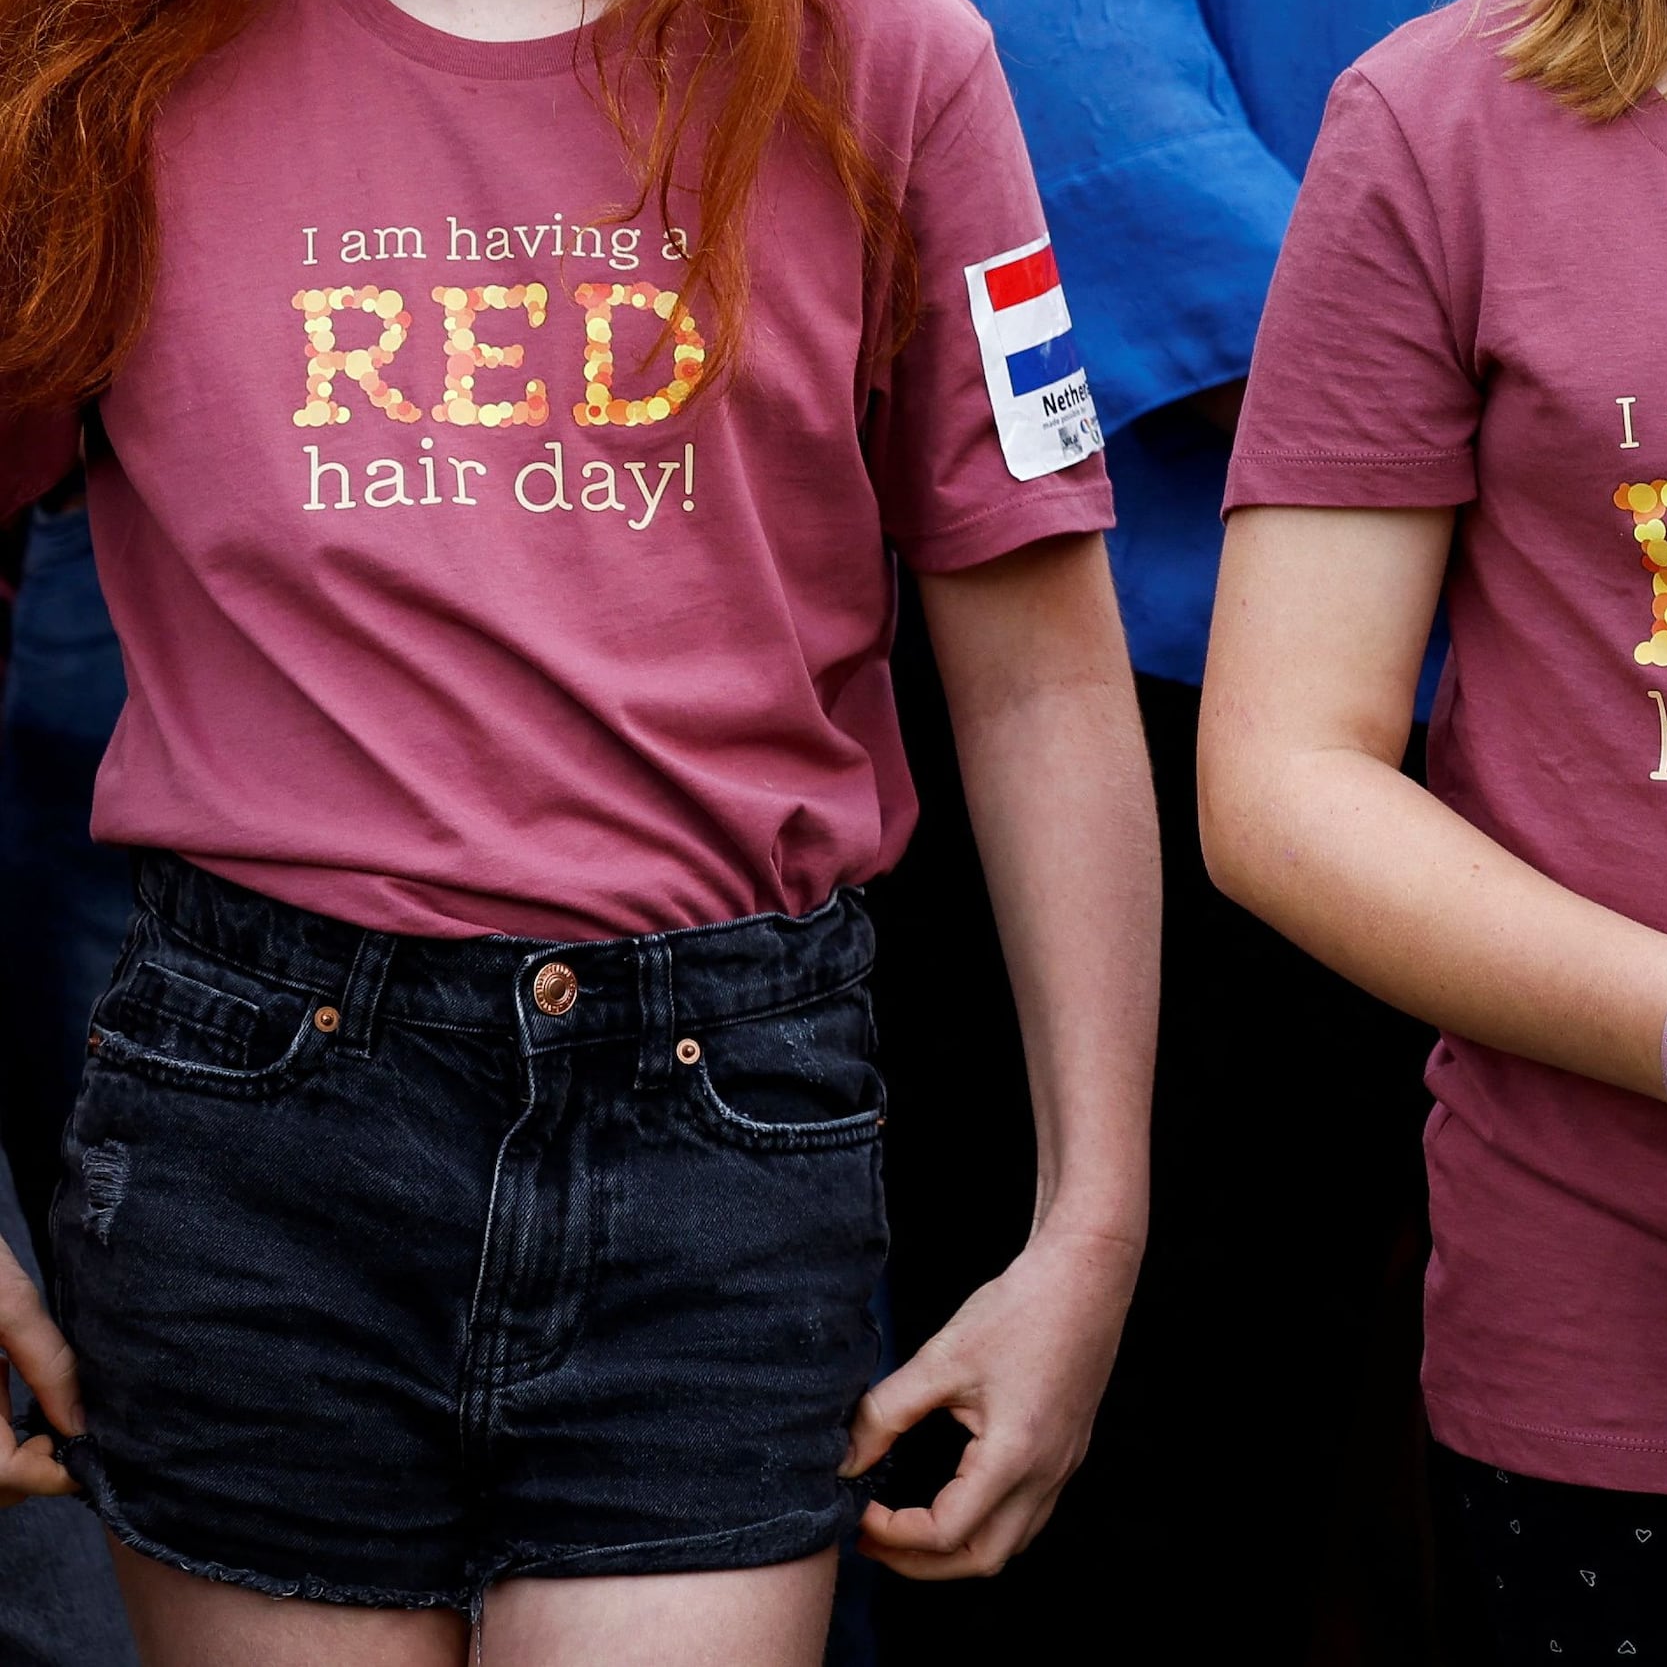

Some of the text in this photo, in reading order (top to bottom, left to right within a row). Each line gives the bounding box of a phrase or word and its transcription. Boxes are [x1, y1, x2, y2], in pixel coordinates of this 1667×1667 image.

[302, 213, 692, 271] I am having a
[291, 283, 706, 428] RED
[1616, 396, 1640, 449] I
[303, 438, 697, 531] hair day!
